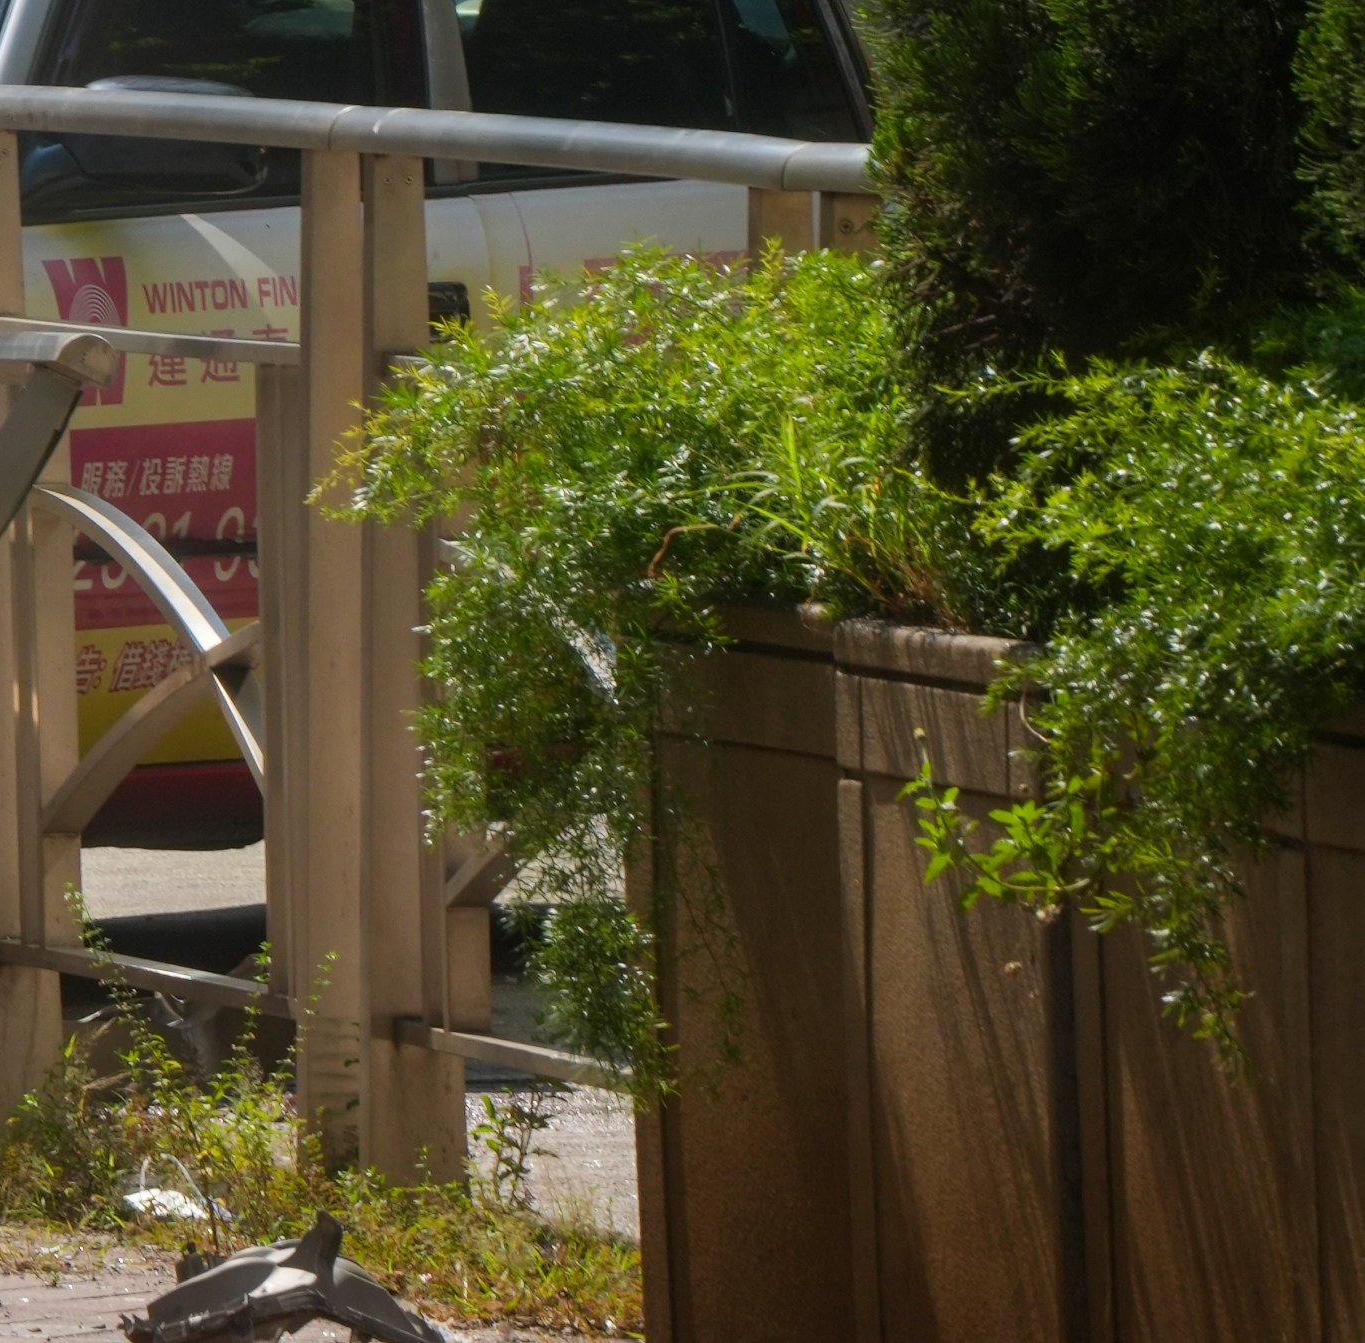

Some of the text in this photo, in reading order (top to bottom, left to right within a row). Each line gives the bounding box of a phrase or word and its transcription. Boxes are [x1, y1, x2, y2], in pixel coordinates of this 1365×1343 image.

[142, 275, 299, 314] WINTON FIN
[80, 452, 235, 498] 服務/投訴熱線
